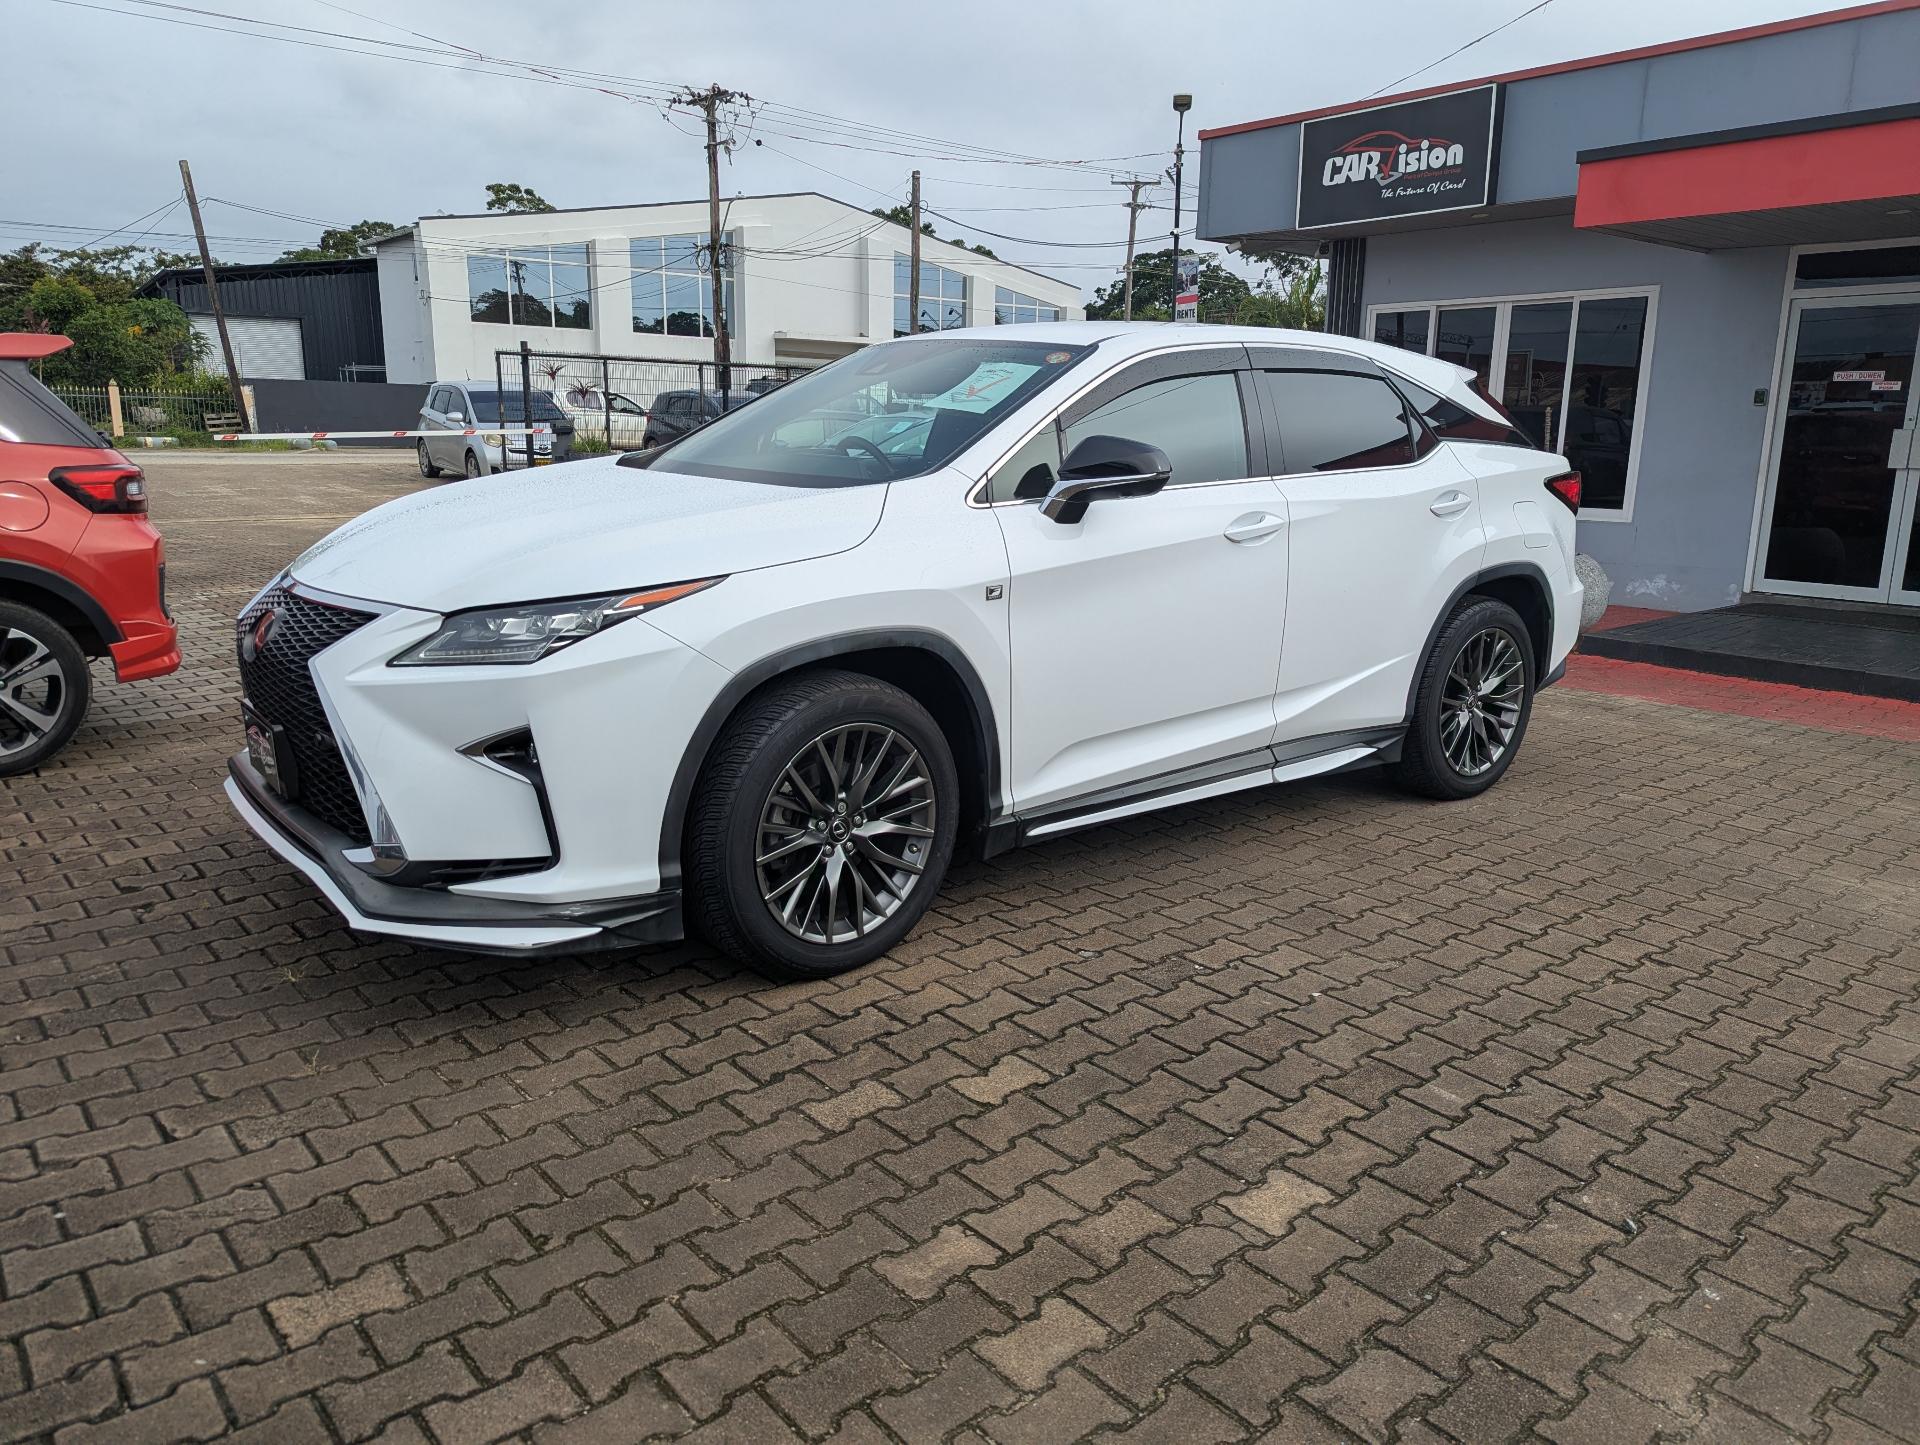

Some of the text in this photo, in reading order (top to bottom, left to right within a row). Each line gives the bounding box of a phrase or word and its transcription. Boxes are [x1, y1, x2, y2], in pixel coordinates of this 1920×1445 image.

[1381, 188, 1394, 198] The
[1395, 186, 1425, 197] Future
[1426, 181, 1440, 194] Of
[1176, 308, 1196, 319] RENTE
[1836, 372, 1854, 380] PUSH
